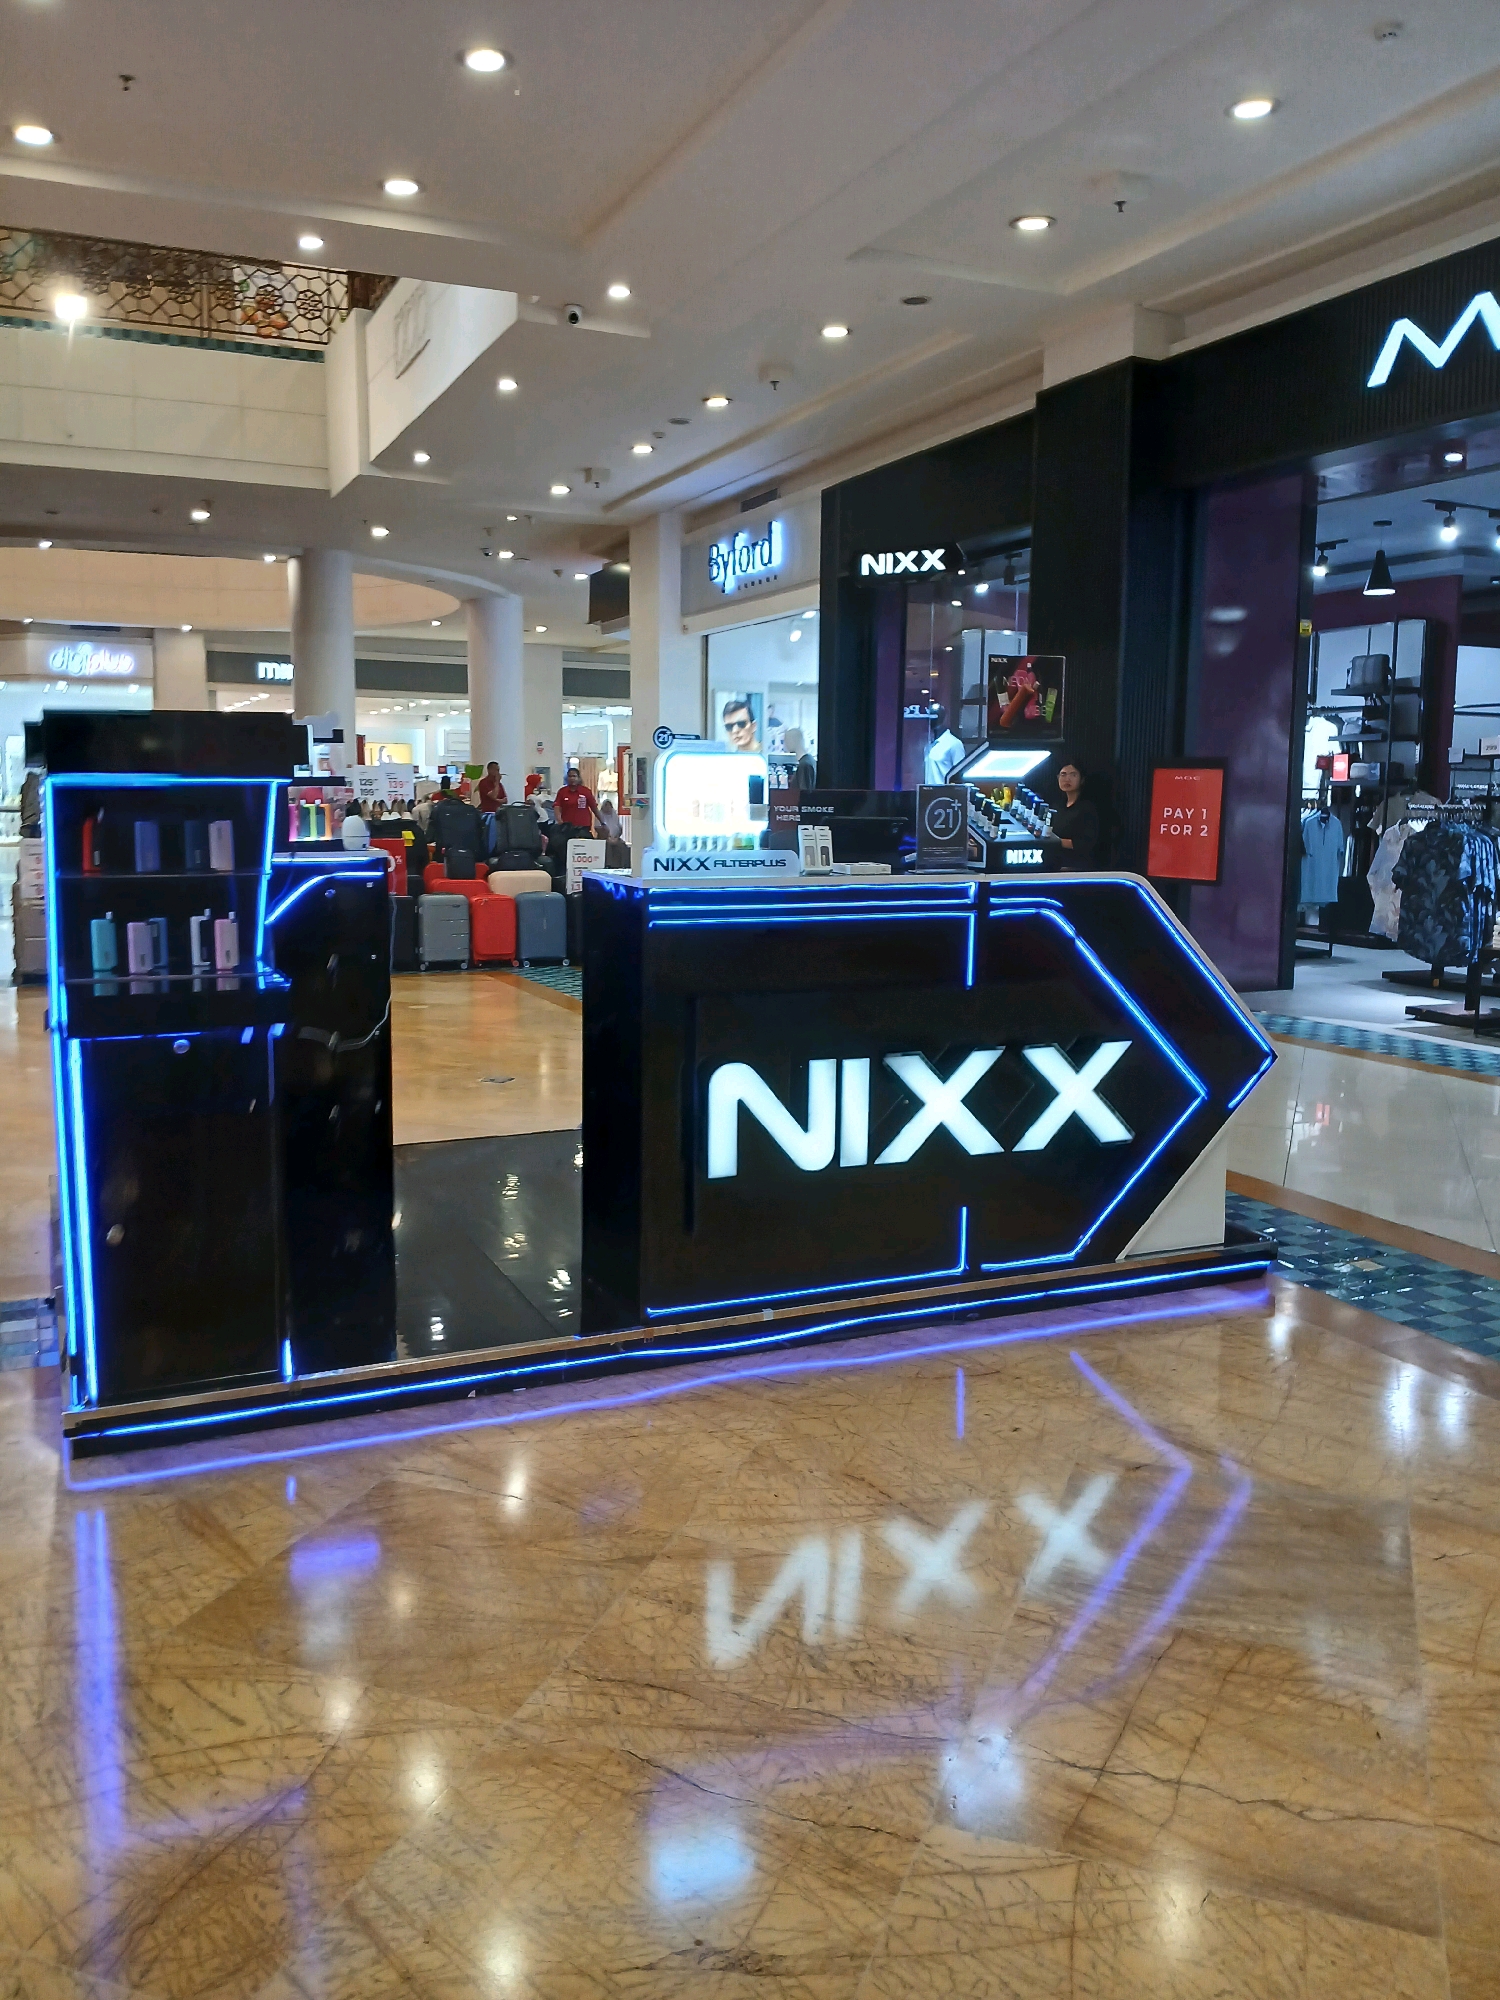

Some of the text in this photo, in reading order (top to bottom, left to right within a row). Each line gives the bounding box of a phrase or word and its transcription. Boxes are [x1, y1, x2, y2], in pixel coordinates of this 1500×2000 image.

[709, 520, 782, 594] Byford
[861, 548, 946, 576] NIXX
[50, 643, 134, 676] digiplus
[933, 798, 962, 829] 21+
[1163, 807, 1207, 820] PAY 1
[1160, 824, 1208, 836] FOR 2
[653, 856, 711, 872] NIXX
[1006, 849, 1044, 864] NIXX
[708, 1040, 1135, 1179] NIXX
